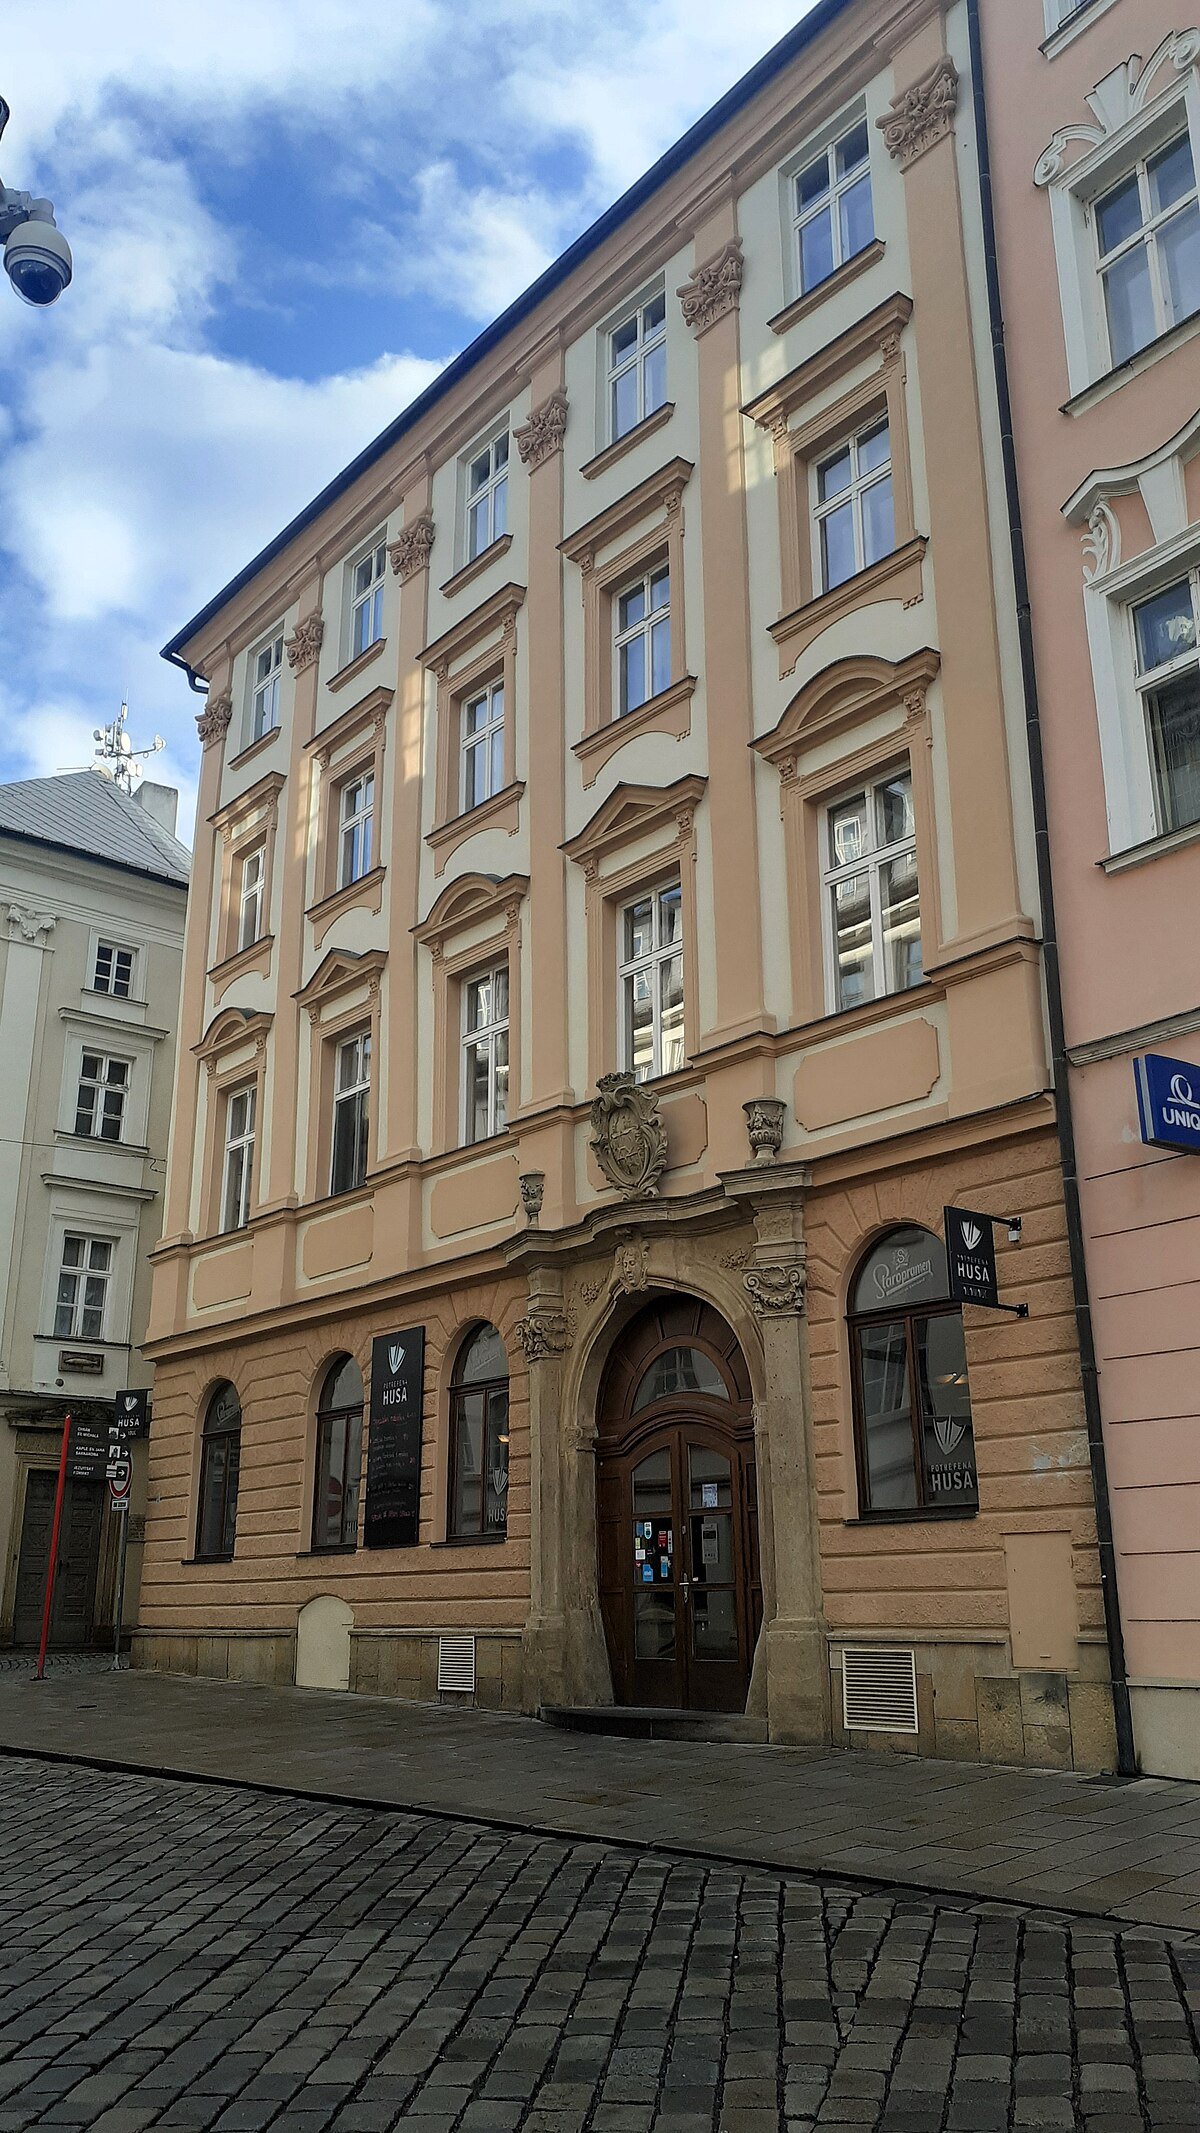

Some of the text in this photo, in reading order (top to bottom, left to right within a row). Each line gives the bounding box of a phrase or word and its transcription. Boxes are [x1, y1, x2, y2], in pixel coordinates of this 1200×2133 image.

[873, 1260, 933, 1299] Staropramen
[957, 1262, 990, 1282] HUSA
[382, 1386, 407, 1406] HUSA
[117, 1417, 140, 1428] HUSA
[931, 1470, 974, 1492] HUSA
